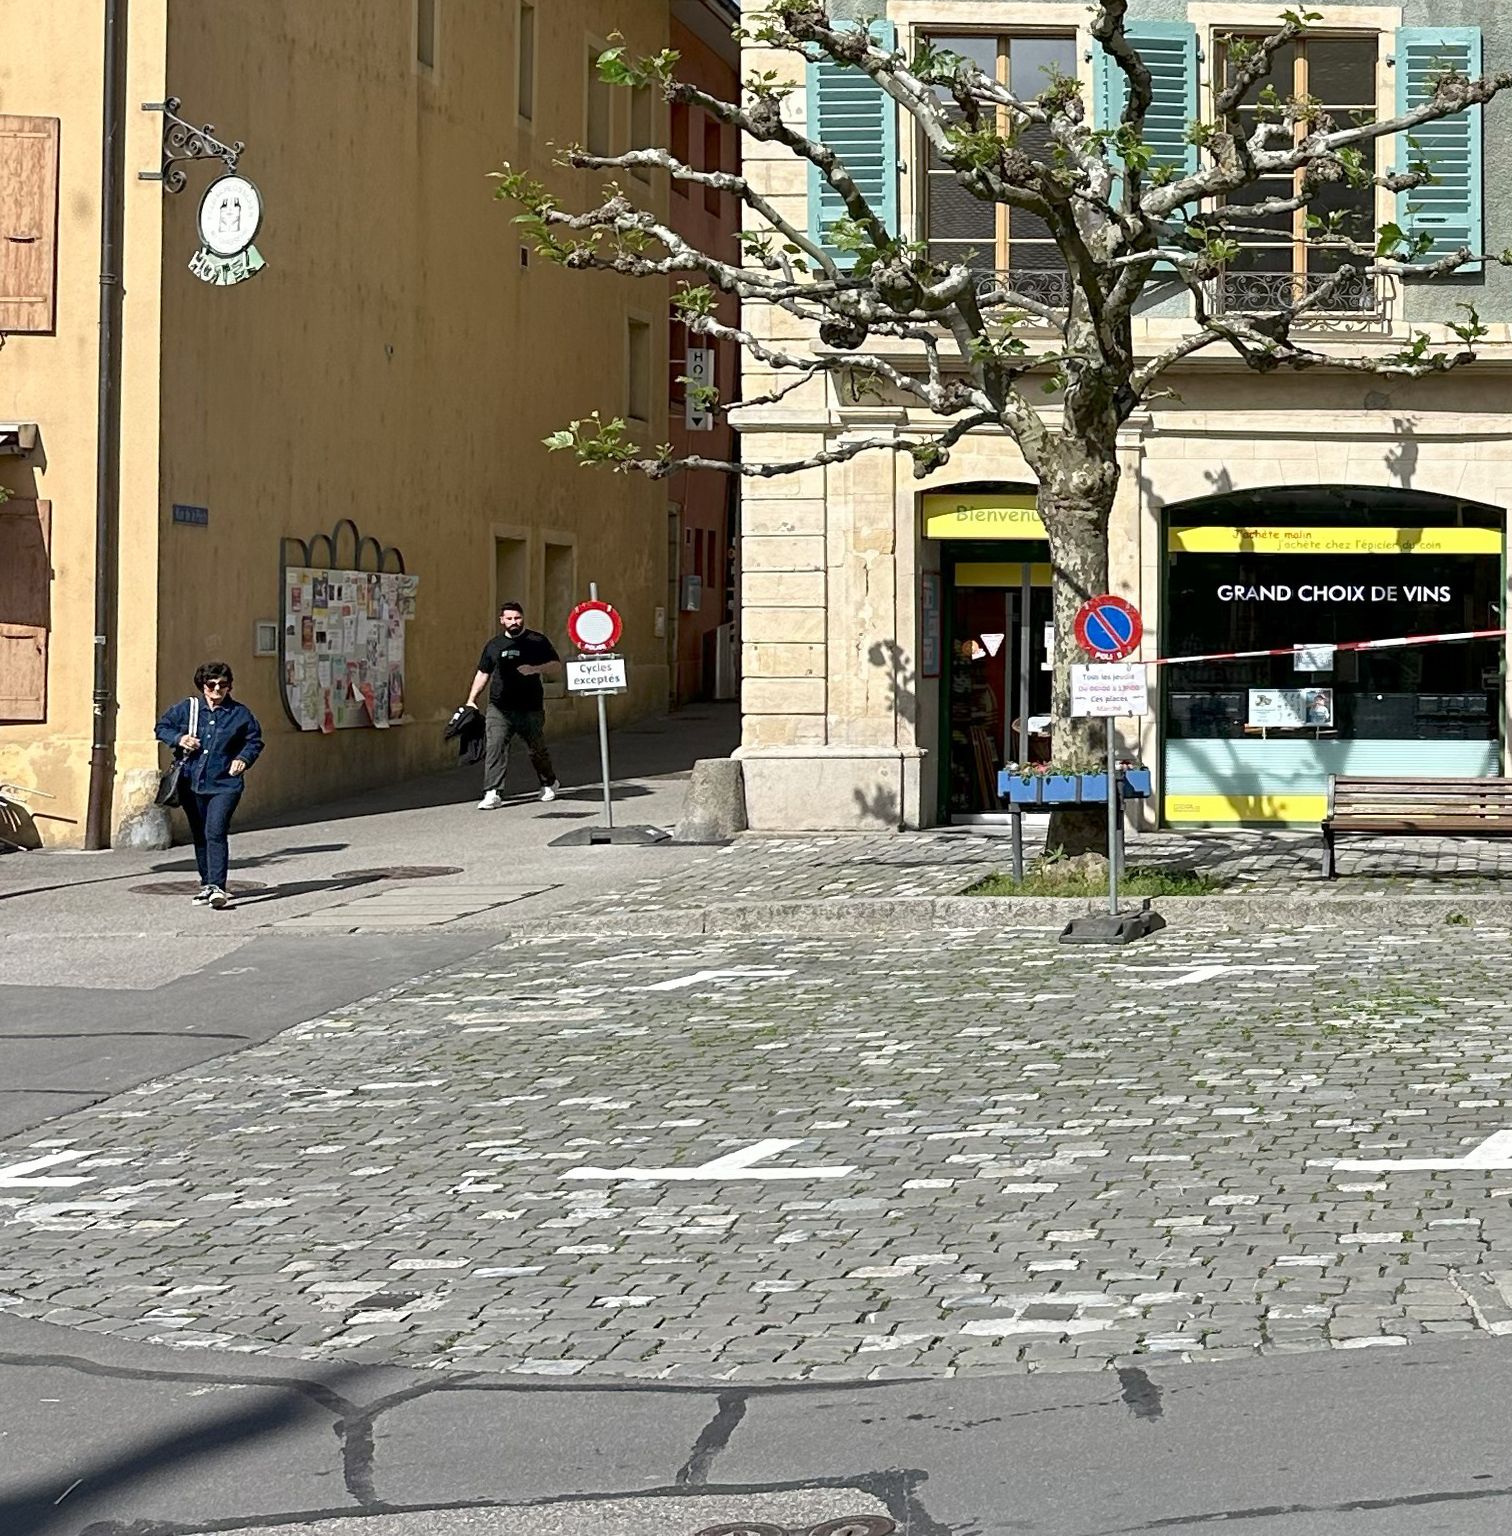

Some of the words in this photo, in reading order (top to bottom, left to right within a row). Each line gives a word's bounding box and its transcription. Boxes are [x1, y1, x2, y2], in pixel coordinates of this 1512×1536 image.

[188, 247, 257, 285] HOTEL
[956, 505, 1043, 522] Bienvenu
[1325, 539, 1351, 549] chez
[1420, 541, 1441, 549] coin
[1217, 585, 1292, 602] GRAND
[1297, 585, 1365, 602] CHOIX
[1371, 586, 1398, 602] DE
[1402, 586, 1451, 602] VINS
[579, 664, 612, 675] Cycles
[574, 673, 620, 686] exceptés
[1105, 695, 1128, 704] places
